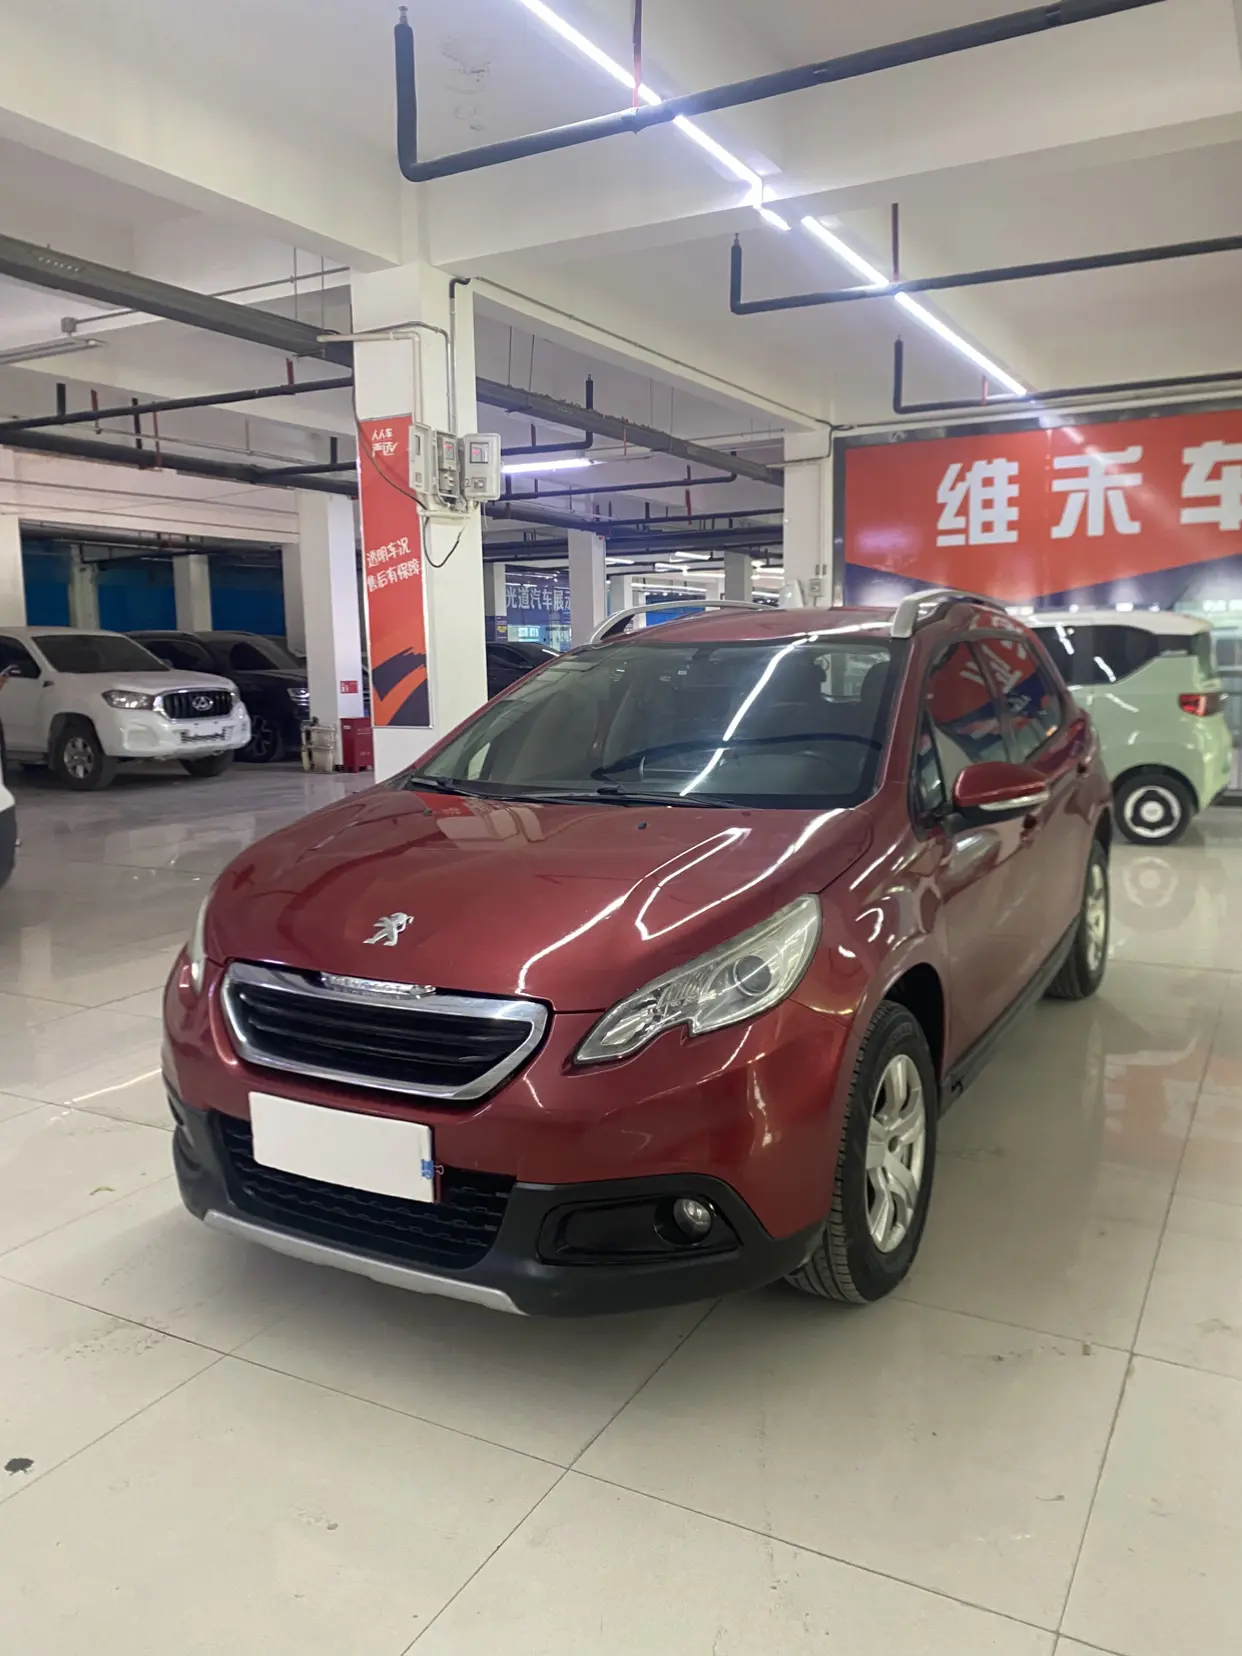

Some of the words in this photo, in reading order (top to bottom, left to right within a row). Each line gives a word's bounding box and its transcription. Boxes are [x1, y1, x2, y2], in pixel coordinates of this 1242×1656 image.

[366, 537, 411, 568] 透明车况
[367, 558, 421, 592] 售后有保障
